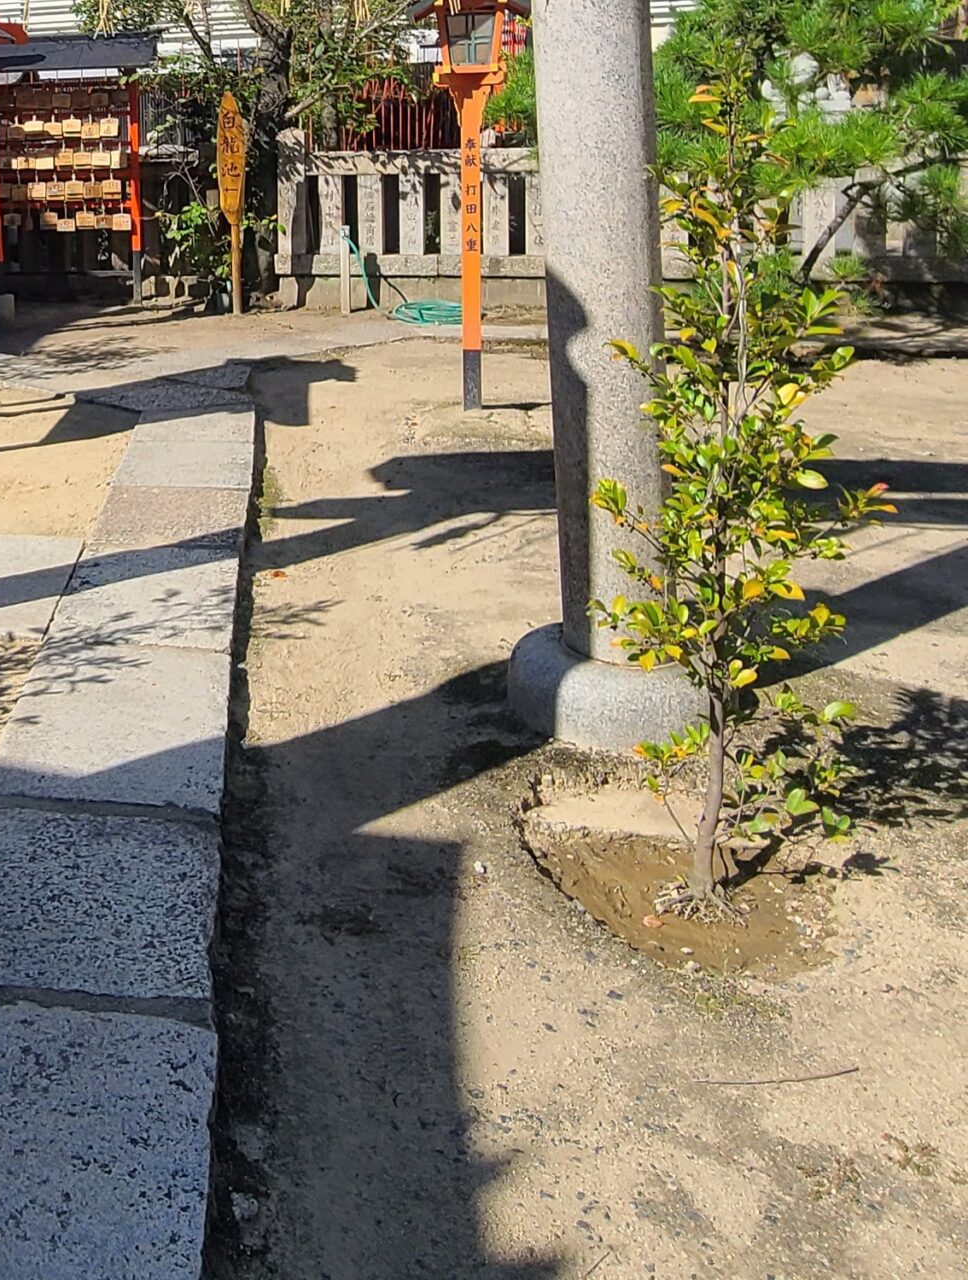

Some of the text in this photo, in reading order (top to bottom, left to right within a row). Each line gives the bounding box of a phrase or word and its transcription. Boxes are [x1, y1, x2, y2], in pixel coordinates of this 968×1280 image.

[220, 110, 241, 178] 白龍池
[464, 136, 479, 252] 奉献 打田八重
